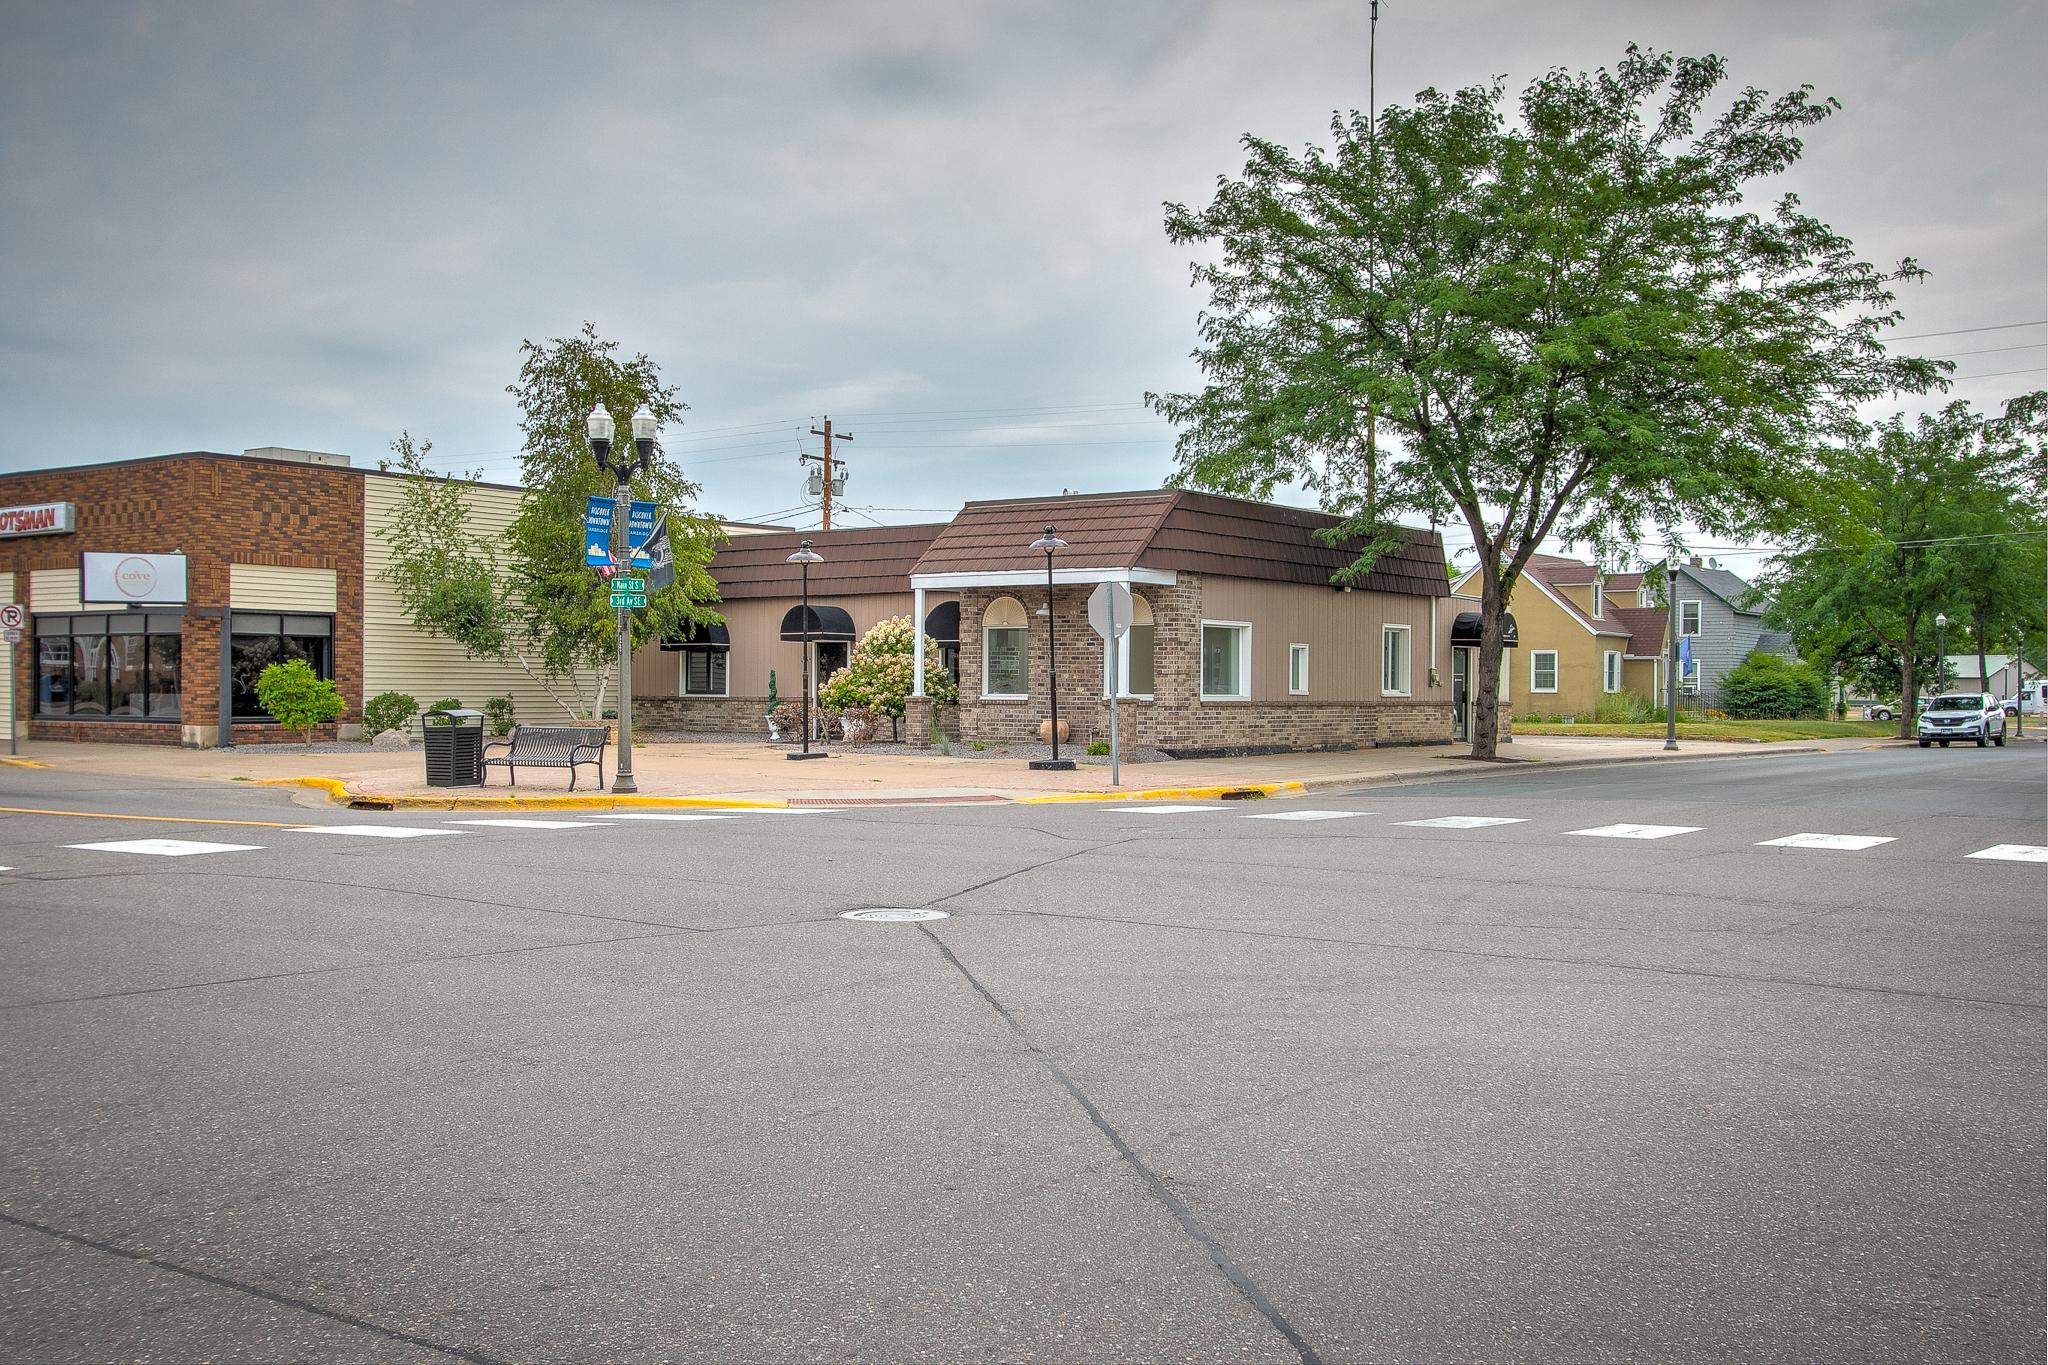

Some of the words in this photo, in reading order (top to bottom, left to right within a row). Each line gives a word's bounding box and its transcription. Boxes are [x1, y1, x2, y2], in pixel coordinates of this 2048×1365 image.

[616, 580, 627, 590] Main
[628, 580, 634, 590] St
[635, 580, 639, 590] S
[616, 596, 625, 606] 3rd
[626, 596, 634, 606] Av
[634, 596, 641, 606] SE
